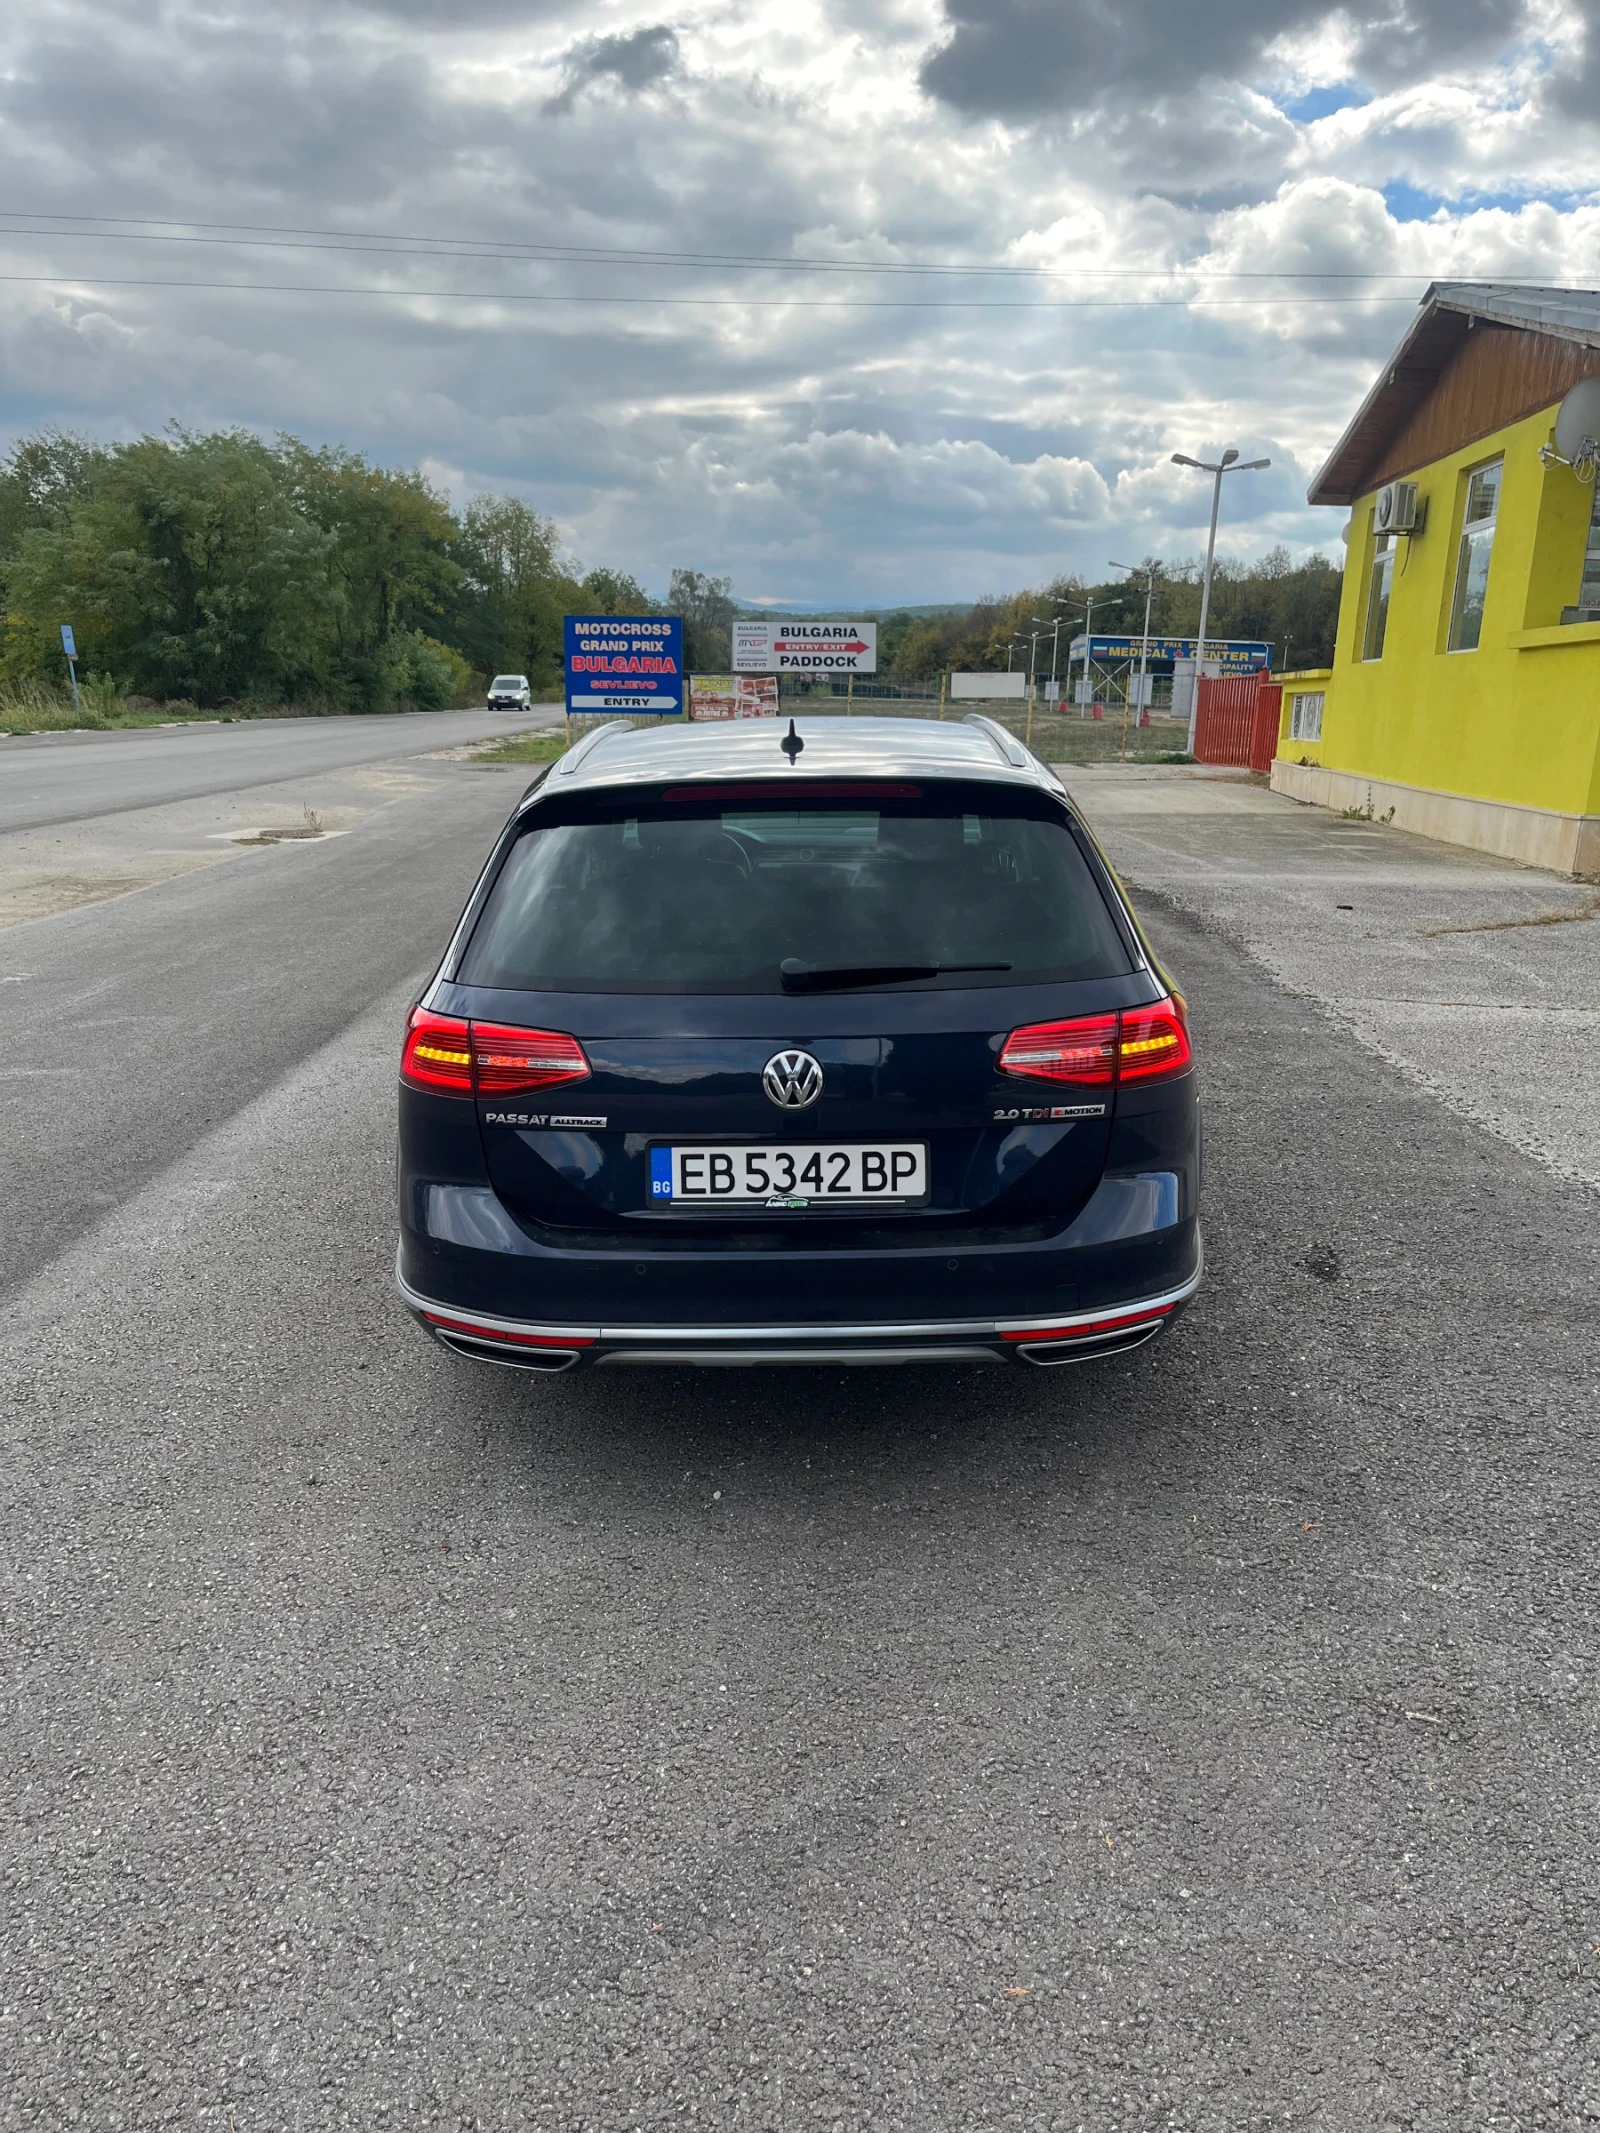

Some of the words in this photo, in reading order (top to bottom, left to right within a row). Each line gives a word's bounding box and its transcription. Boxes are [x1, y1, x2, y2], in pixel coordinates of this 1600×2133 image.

[575, 623, 671, 636] MOTOCROSS
[780, 627, 858, 638] BULGARIA
[580, 640, 628, 651] GRAND
[632, 641, 664, 652] PRIX
[1108, 647, 1168, 658] MEDICAL
[1189, 649, 1249, 661] CENTER
[571, 655, 677, 673] BULGARIA
[780, 656, 858, 667] PADDOCK
[590, 680, 657, 690] SEVLIEVO
[604, 697, 650, 706] ENTRY
[485, 1113, 549, 1125] PASSAT
[553, 1117, 604, 1126] ALLTRACK
[1021, 1108, 1050, 1119] TDI
[680, 1153, 736, 1195] EB
[745, 1152, 851, 1193] 5342
[861, 1151, 917, 1192] BP
[652, 1180, 671, 1194] BG
